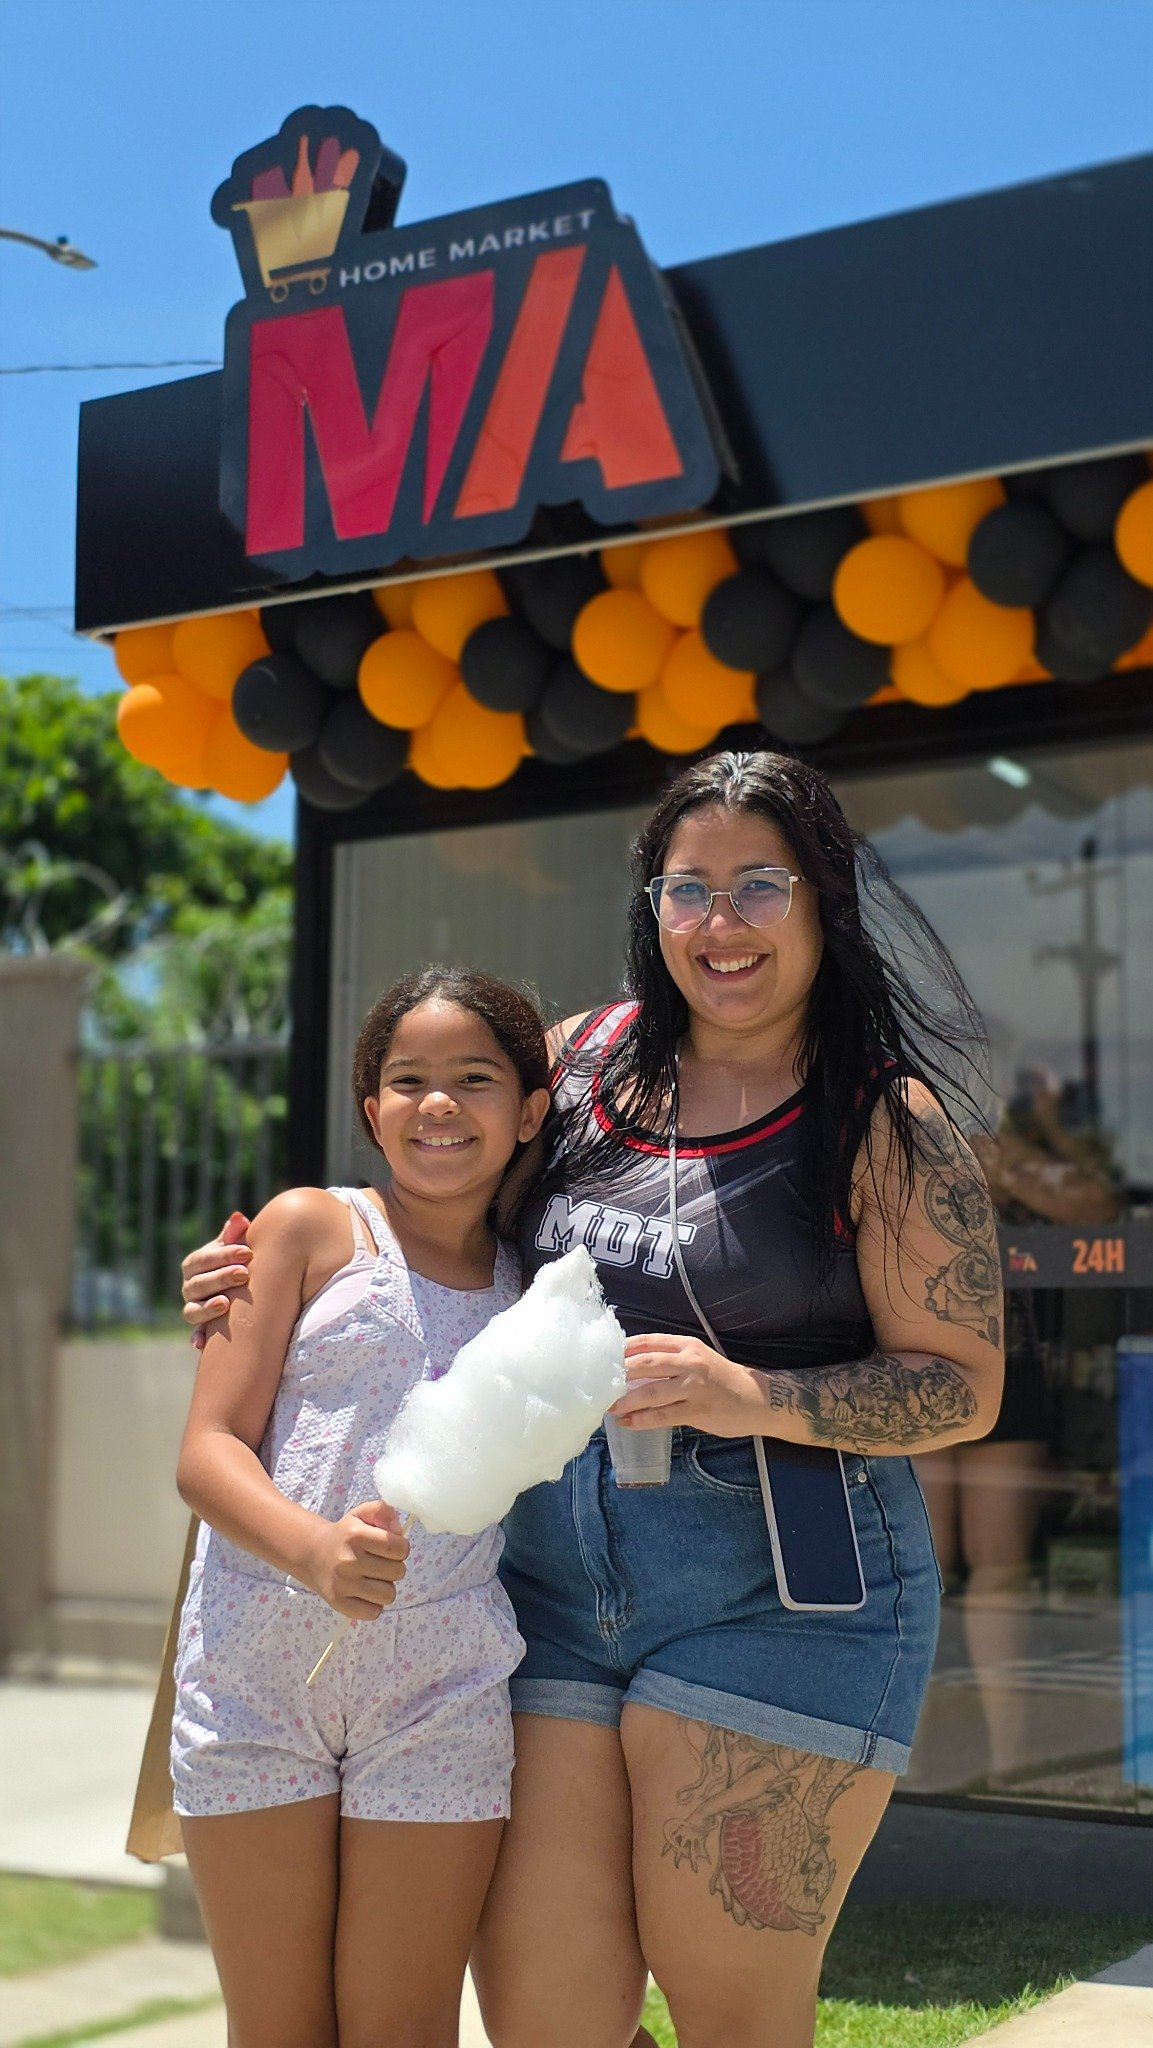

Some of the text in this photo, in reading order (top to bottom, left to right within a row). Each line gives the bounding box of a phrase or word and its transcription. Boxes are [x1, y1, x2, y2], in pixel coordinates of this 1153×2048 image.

[338, 208, 597, 288] HOME MARKET
[246, 244, 684, 557] MA
[535, 1194, 698, 1279] MDT
[1072, 1238, 1126, 1274] 24H
